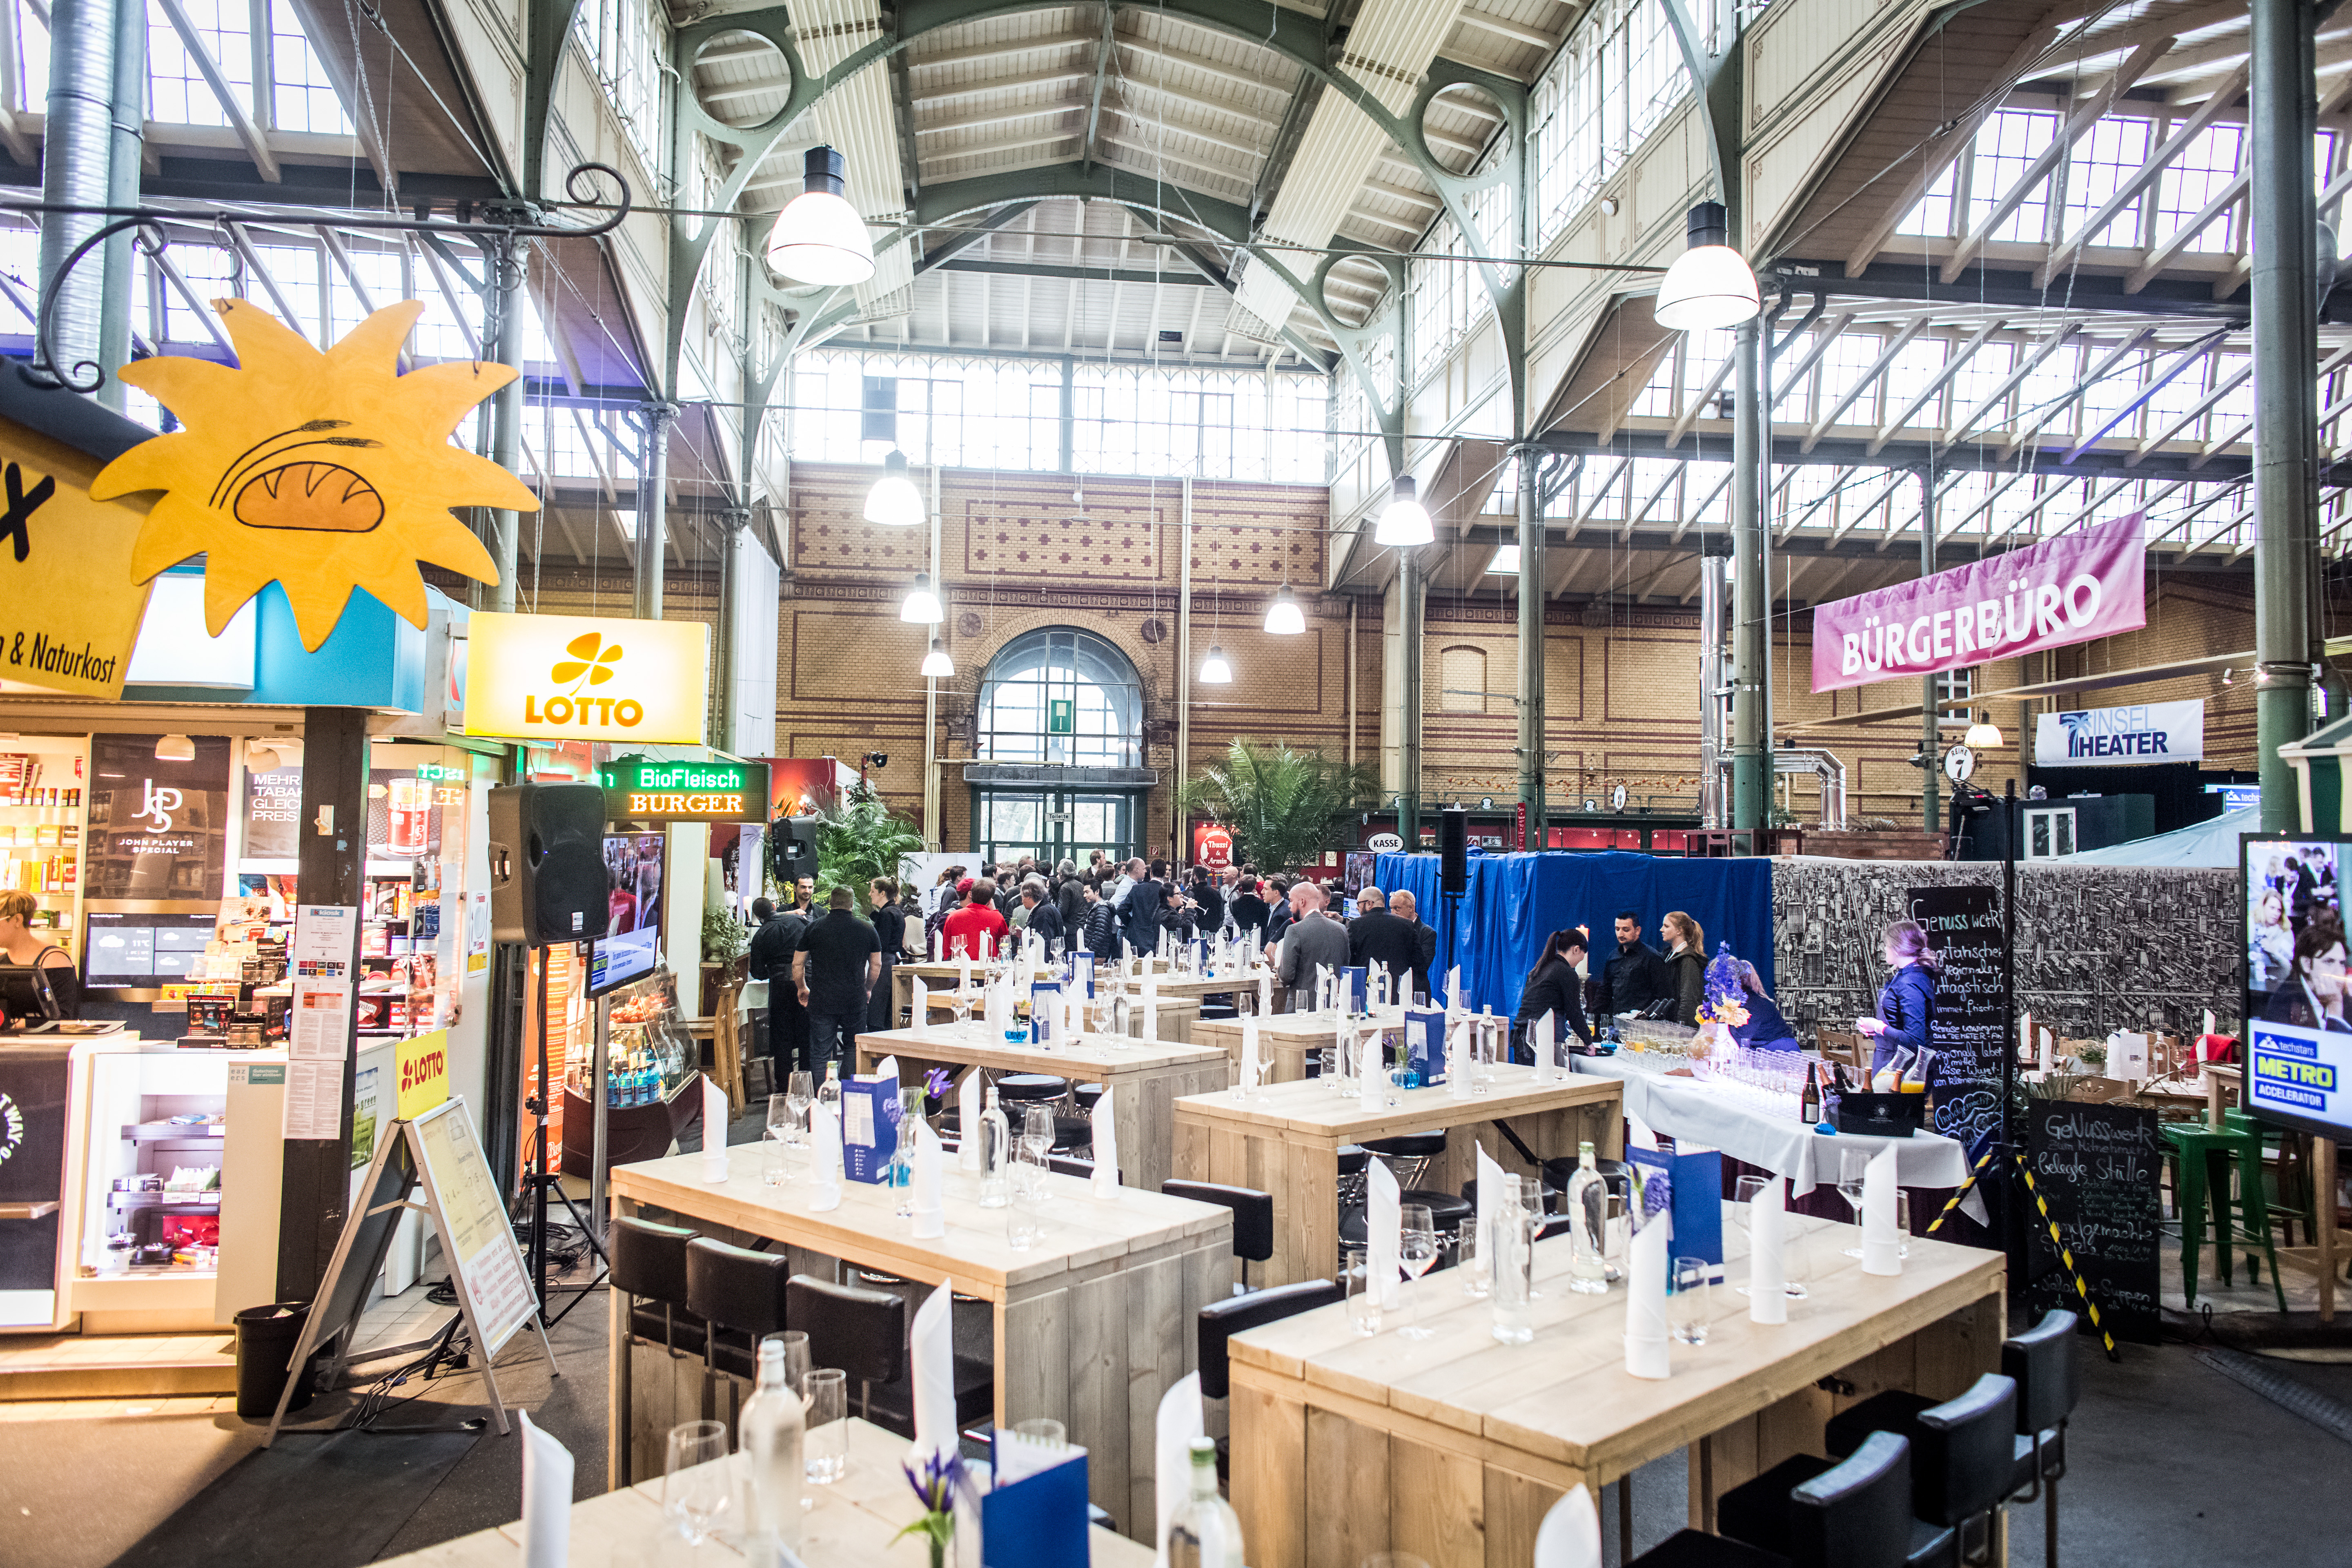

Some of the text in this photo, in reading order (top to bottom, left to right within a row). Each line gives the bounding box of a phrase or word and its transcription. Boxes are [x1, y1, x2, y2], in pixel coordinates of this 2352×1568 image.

[1842, 573, 2101, 676] BÜRGERBÜRO
[30, 633, 116, 684] Naturkost
[525, 695, 644, 727] LOTTO
[2094, 706, 2157, 735] INSEL
[1951, 748, 1968, 756] REIHE
[2145, 753, 2169, 762] moabit
[641, 768, 739, 788] BioFleisch
[1956, 760, 1964, 778] 7
[254, 774, 301, 785] MEHR
[630, 794, 744, 813] BURGER
[1618, 794, 1622, 806] 8
[2241, 793, 2260, 802] techs
[252, 810, 298, 822] PREIS
[1373, 840, 1399, 848] KASSE
[1911, 898, 1969, 932] Genuss
[360, 1002, 375, 1013] nston
[2279, 1042, 2314, 1056] techstars
[414, 1050, 443, 1086] LOTTO
[2258, 1056, 2333, 1087] METRO
[2258, 1084, 2322, 1107] ACCELERATOR
